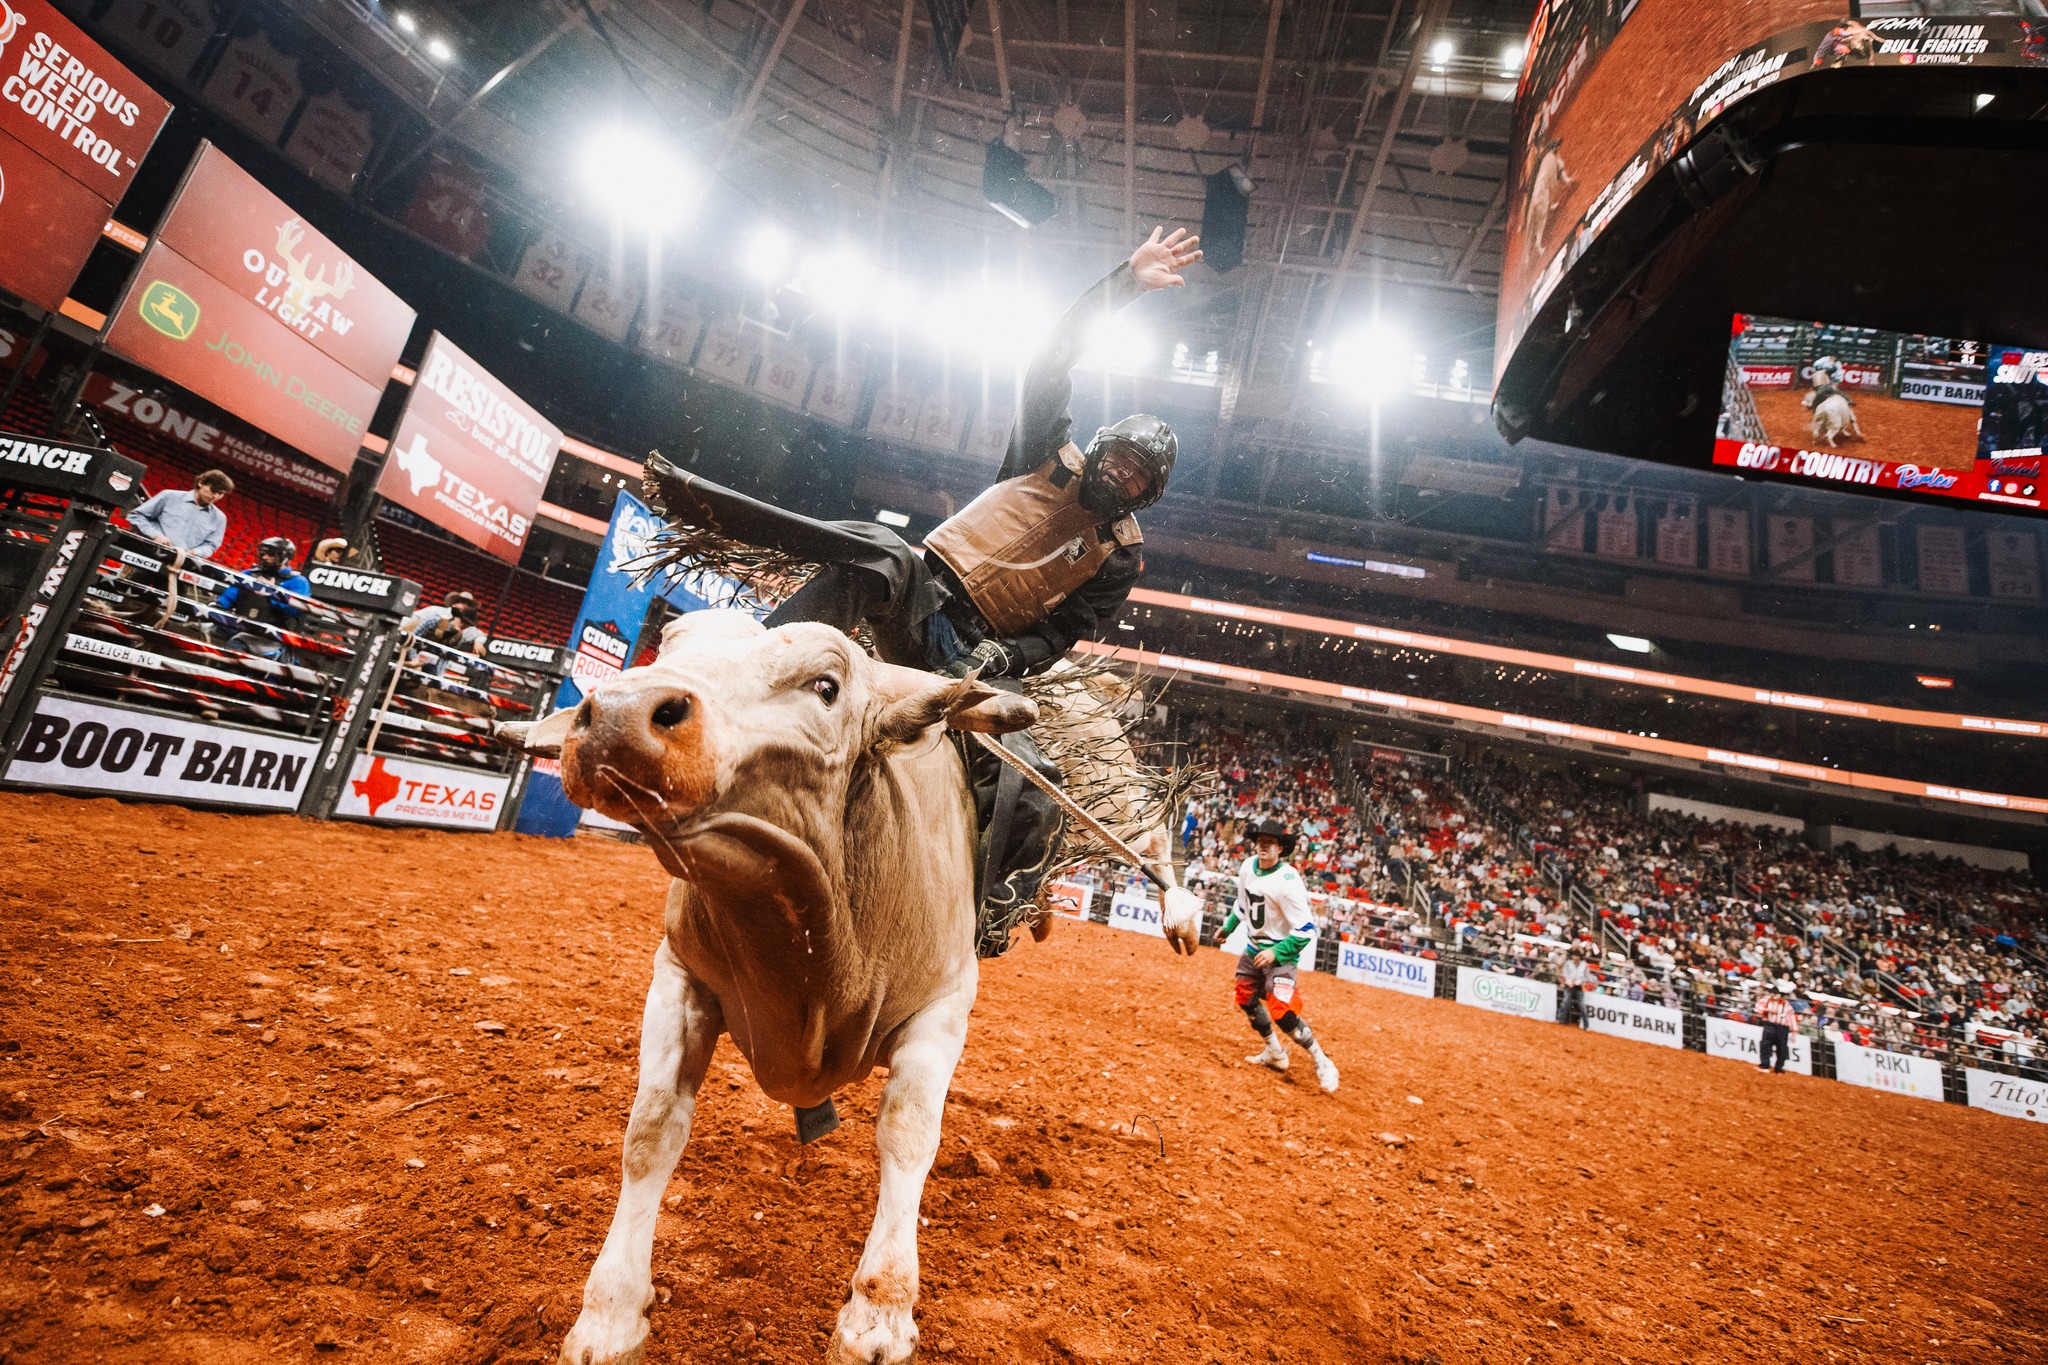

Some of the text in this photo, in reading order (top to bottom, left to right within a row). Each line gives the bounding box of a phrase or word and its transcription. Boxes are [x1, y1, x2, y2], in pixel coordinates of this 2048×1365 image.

[1866, 17, 1931, 31] ETHAN
[1917, 25, 1985, 39] PITMAN
[1878, 39, 1989, 54] BULL FIGHTER
[18, 51, 97, 123] WEED
[28, 31, 140, 127] SERIOUS
[243, 249, 354, 336] OUTLAW
[254, 287, 324, 339] LIGHT
[205, 331, 364, 436] JOHN DEERE
[1903, 382, 1942, 398] BOOT
[103, 381, 221, 452] ZONE
[421, 348, 553, 473] RESISTOL
[471, 426, 496, 449] best
[1736, 442, 1958, 489] GOD COUNTRY Rodeo
[434, 490, 484, 527] PRECIOUS
[443, 470, 528, 536] TEXAS
[124, 553, 158, 570] CINCH
[309, 567, 391, 597] CINCH
[72, 636, 155, 666] RALEIGH, NC
[488, 639, 555, 663] CINCH
[582, 625, 629, 660] CINCH
[324, 688, 365, 771] RODEO
[13, 713, 308, 793] BOOT BARN
[404, 780, 497, 811] TEXAS
[394, 804, 491, 823] PRECIOUS METALS
[1116, 904, 1159, 924] CIN
[1343, 950, 1427, 982] RESISTOL
[1586, 1004, 1676, 1036] BOOT BARN
[1874, 1053, 1911, 1075] RIKI
